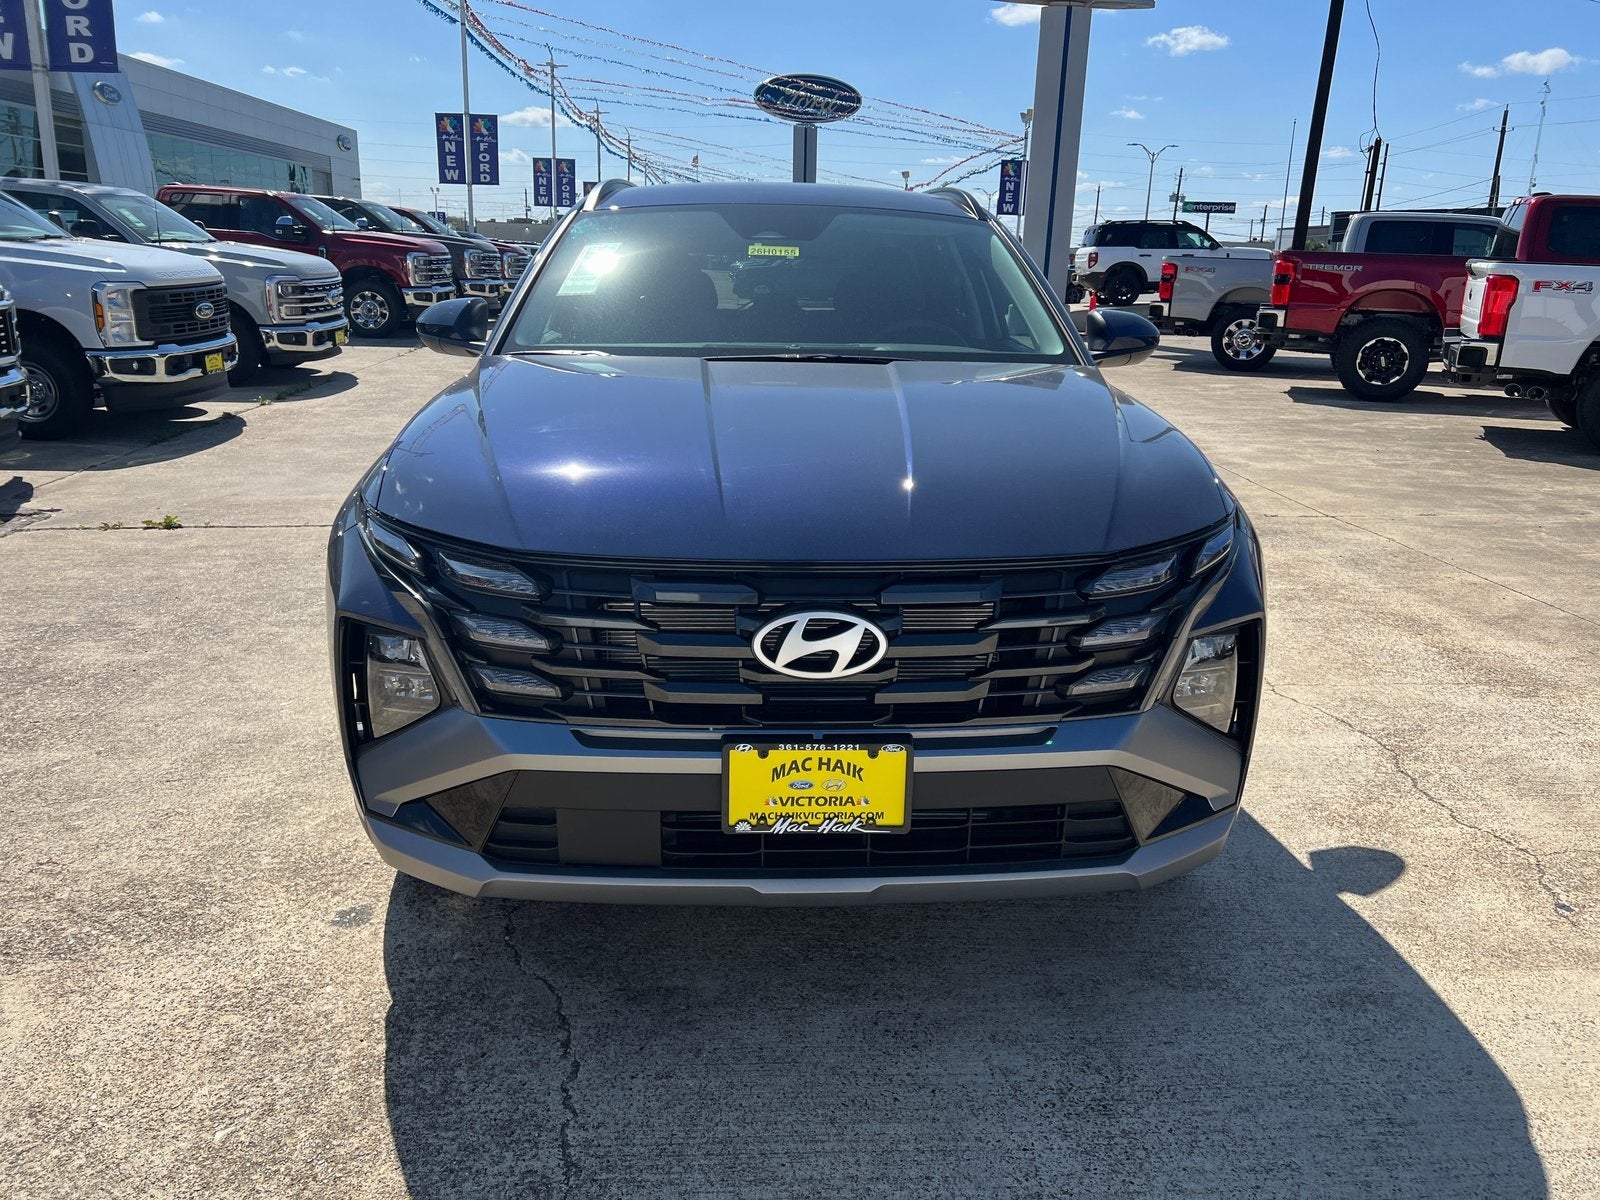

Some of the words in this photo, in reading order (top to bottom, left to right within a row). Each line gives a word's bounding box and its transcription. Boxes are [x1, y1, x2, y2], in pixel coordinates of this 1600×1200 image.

[444, 141, 459, 181] NEW
[478, 142, 490, 183] FORD
[538, 177, 548, 205] NEW
[561, 178, 570, 206] FORD
[1002, 181, 1014, 213] NEW
[1186, 203, 1235, 212] enterprise
[750, 247, 796, 256] 26H0155
[1308, 263, 1363, 272] TREMOR
[1532, 280, 1593, 293] FX4
[778, 743, 861, 751] 361-576-1221
[771, 757, 813, 782] MAC
[817, 757, 864, 782] HAIK
[778, 796, 856, 807] VICTORIA
[749, 811, 885, 820] MACHAIKVICTORIA.COM
[769, 817, 813, 834] Mac
[817, 817, 864, 834] Haik
